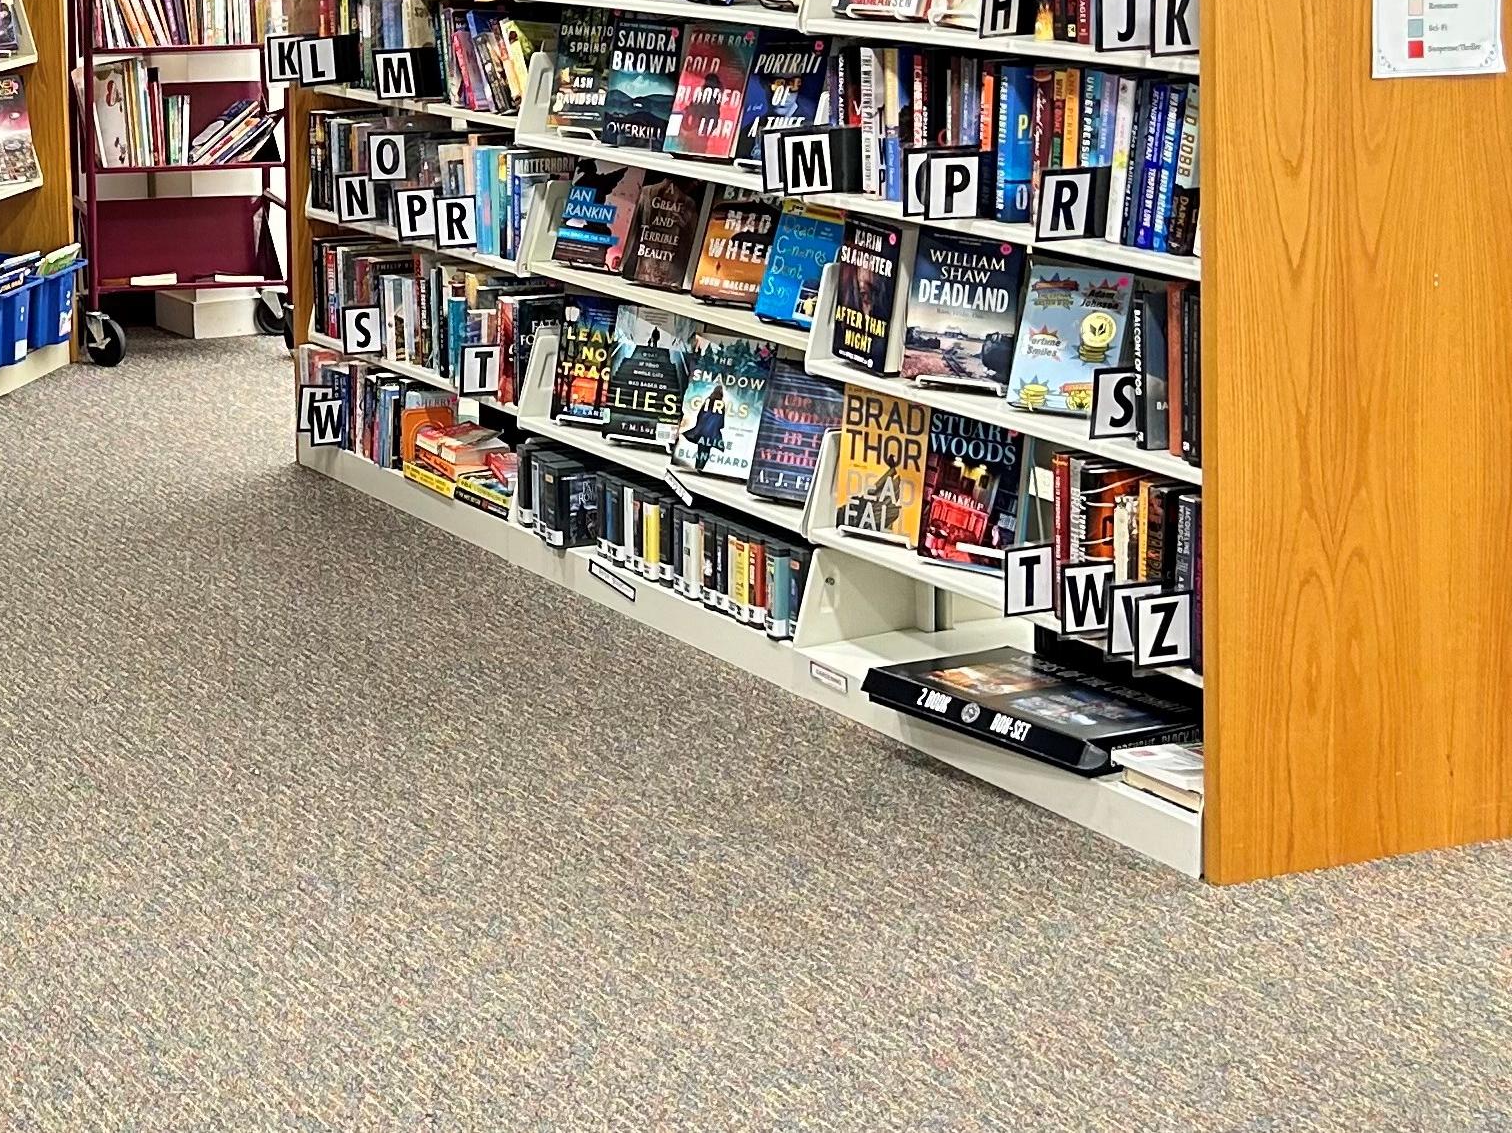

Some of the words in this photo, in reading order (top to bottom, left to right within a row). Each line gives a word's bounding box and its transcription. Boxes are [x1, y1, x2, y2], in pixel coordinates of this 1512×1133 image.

[617, 28, 678, 53] SANDRA
[278, 41, 299, 77] K
[309, 43, 326, 79] L
[382, 57, 414, 94] M
[611, 52, 678, 74] BROWN
[753, 52, 823, 75] PORTRAIT
[606, 122, 662, 140] OVERKILL
[375, 138, 400, 176] O
[790, 140, 829, 190] M
[344, 175, 369, 217] N
[406, 194, 427, 233] P
[447, 202, 468, 242] R
[569, 188, 593, 203] IAN
[944, 163, 972, 213] P
[1049, 179, 1080, 232] R
[565, 203, 613, 222] RANKIN
[854, 228, 882, 253] KARIN
[840, 244, 893, 277] SLAUGHTER
[929, 248, 1007, 272] WILLIAM
[939, 268, 992, 284] SHAW
[917, 279, 1010, 314] DEADLAND
[354, 311, 372, 356] S
[834, 305, 862, 331] AFTER
[863, 316, 888, 338] THAT
[843, 329, 874, 357] NIGHT
[474, 351, 494, 389] T
[692, 368, 766, 391] SHADOW
[614, 387, 679, 416] LIES
[690, 397, 749, 418] GIRLS
[846, 395, 926, 436] BRAD
[1108, 374, 1135, 428] S
[313, 400, 342, 440] W
[678, 447, 750, 470] BLANCHARD
[845, 428, 922, 473] THOR
[930, 432, 1017, 465] WOODS
[939, 489, 984, 510] SHAKEUP
[1018, 554, 1041, 607] T
[1066, 571, 1114, 628] W
[1148, 601, 1180, 659] Z
